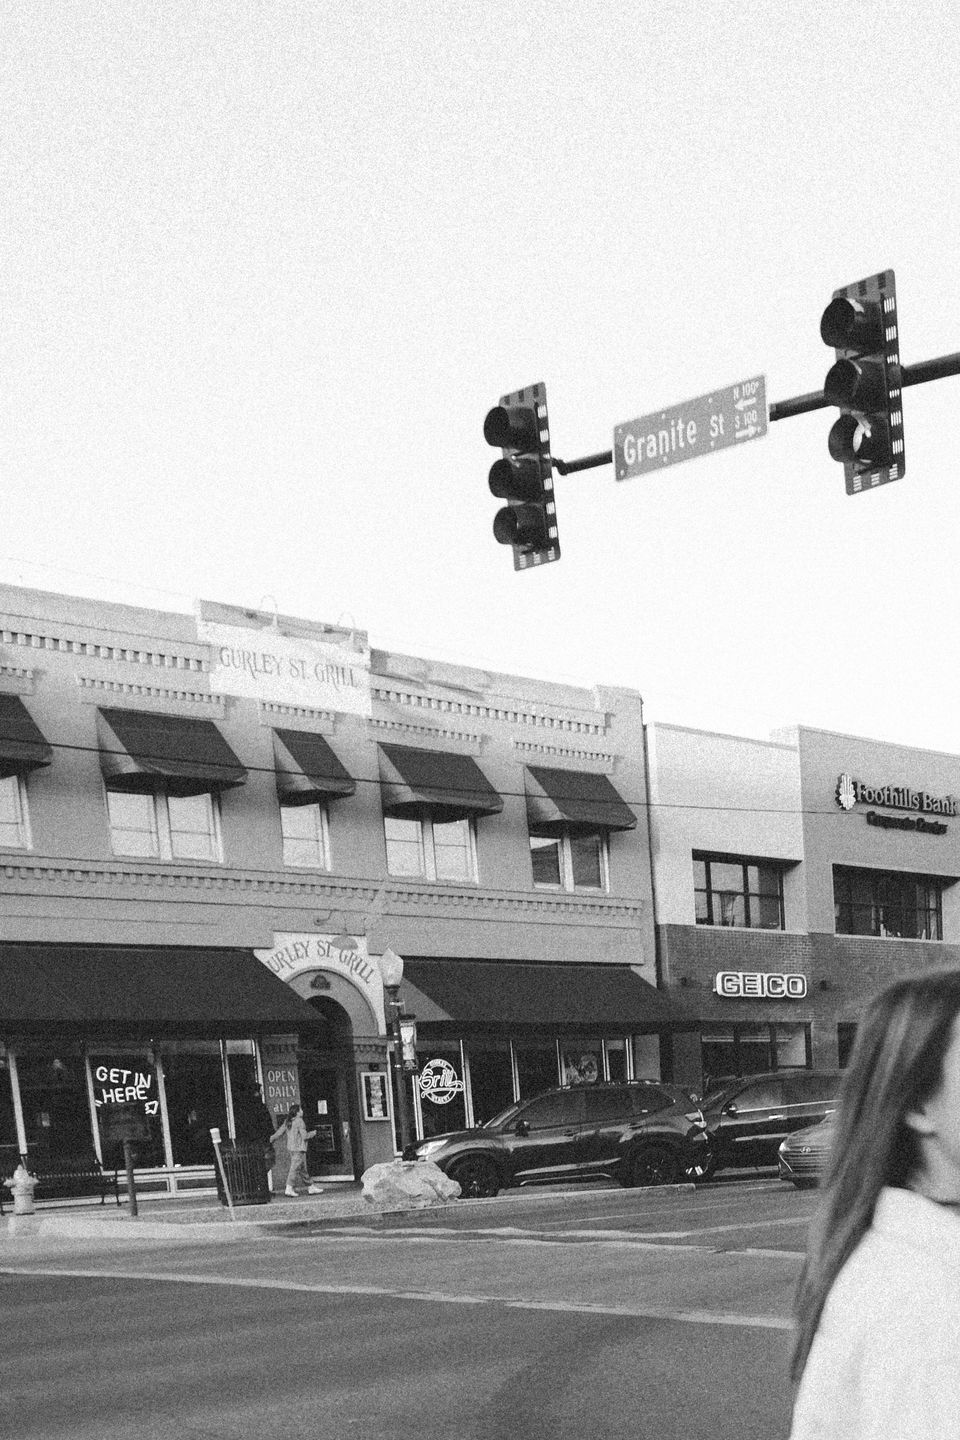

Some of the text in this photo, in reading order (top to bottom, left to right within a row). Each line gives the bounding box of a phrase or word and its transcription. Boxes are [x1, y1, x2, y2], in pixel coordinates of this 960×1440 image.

[732, 382, 758, 401] N 100
[735, 410, 758, 431] S 100
[623, 413, 725, 466] Granite St
[219, 646, 282, 681] GURLEY
[313, 662, 360, 693] GRILL
[855, 782, 959, 816] Foothills Bank
[266, 940, 311, 974] URLEY
[338, 948, 375, 985] GRILL
[716, 971, 808, 999] GEICO
[95, 1065, 152, 1090] GET IN
[266, 1070, 296, 1083] OPEN
[419, 1067, 464, 1092] Grill
[101, 1086, 149, 1104] HERE
[268, 1085, 297, 1098] DAILY
